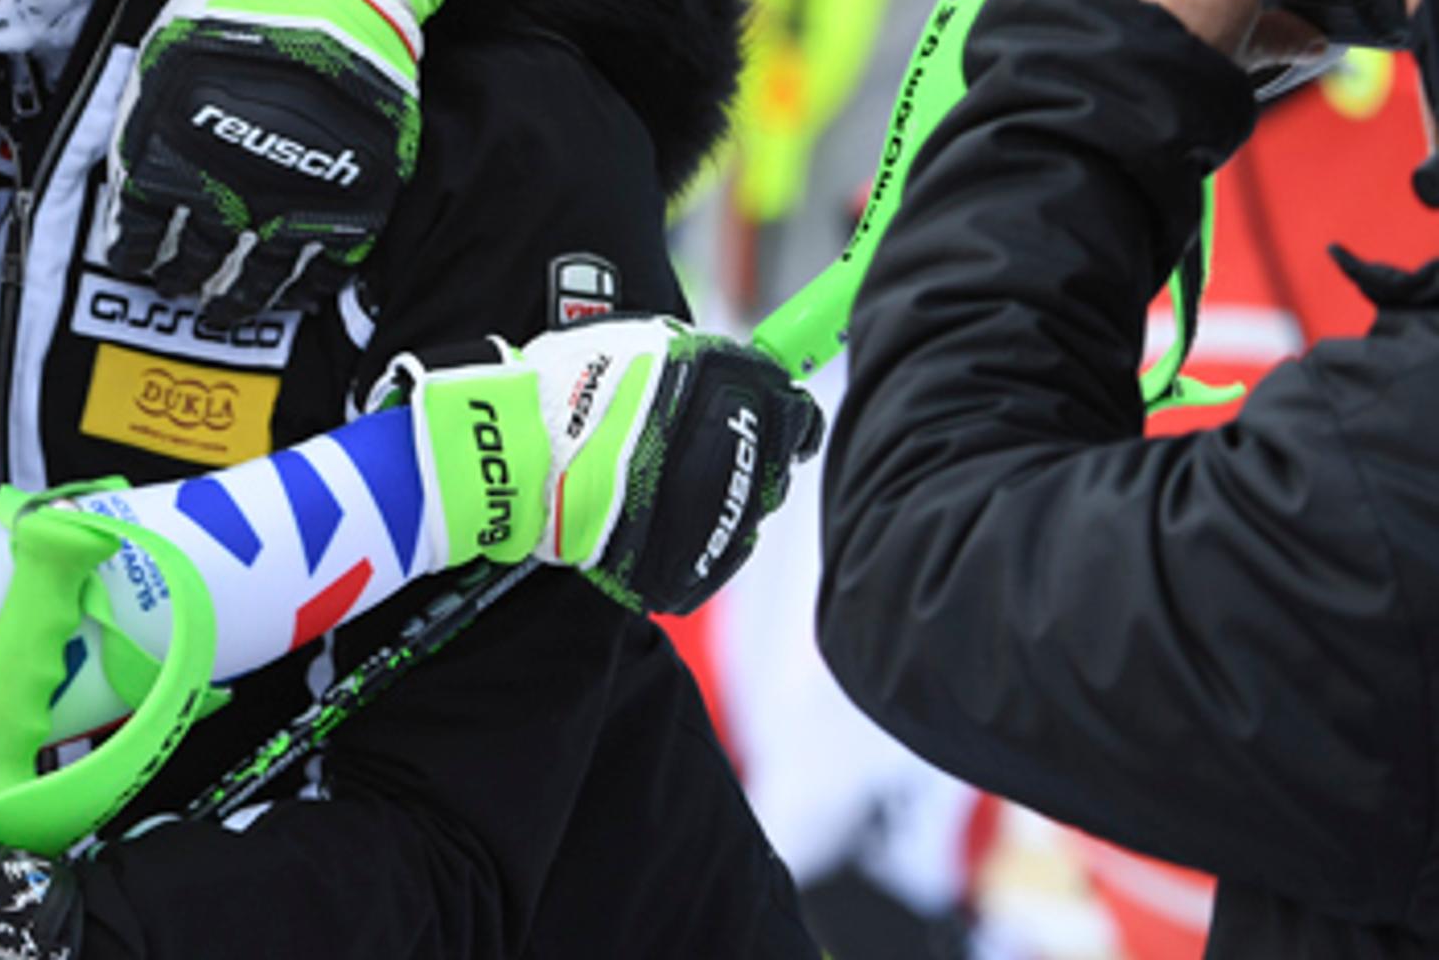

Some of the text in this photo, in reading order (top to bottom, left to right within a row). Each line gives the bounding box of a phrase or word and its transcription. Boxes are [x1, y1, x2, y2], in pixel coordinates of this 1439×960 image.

[192, 103, 361, 187] reusch
[141, 379, 236, 419] DUKLA
[468, 399, 519, 547] racing
[694, 406, 760, 579] reusch
